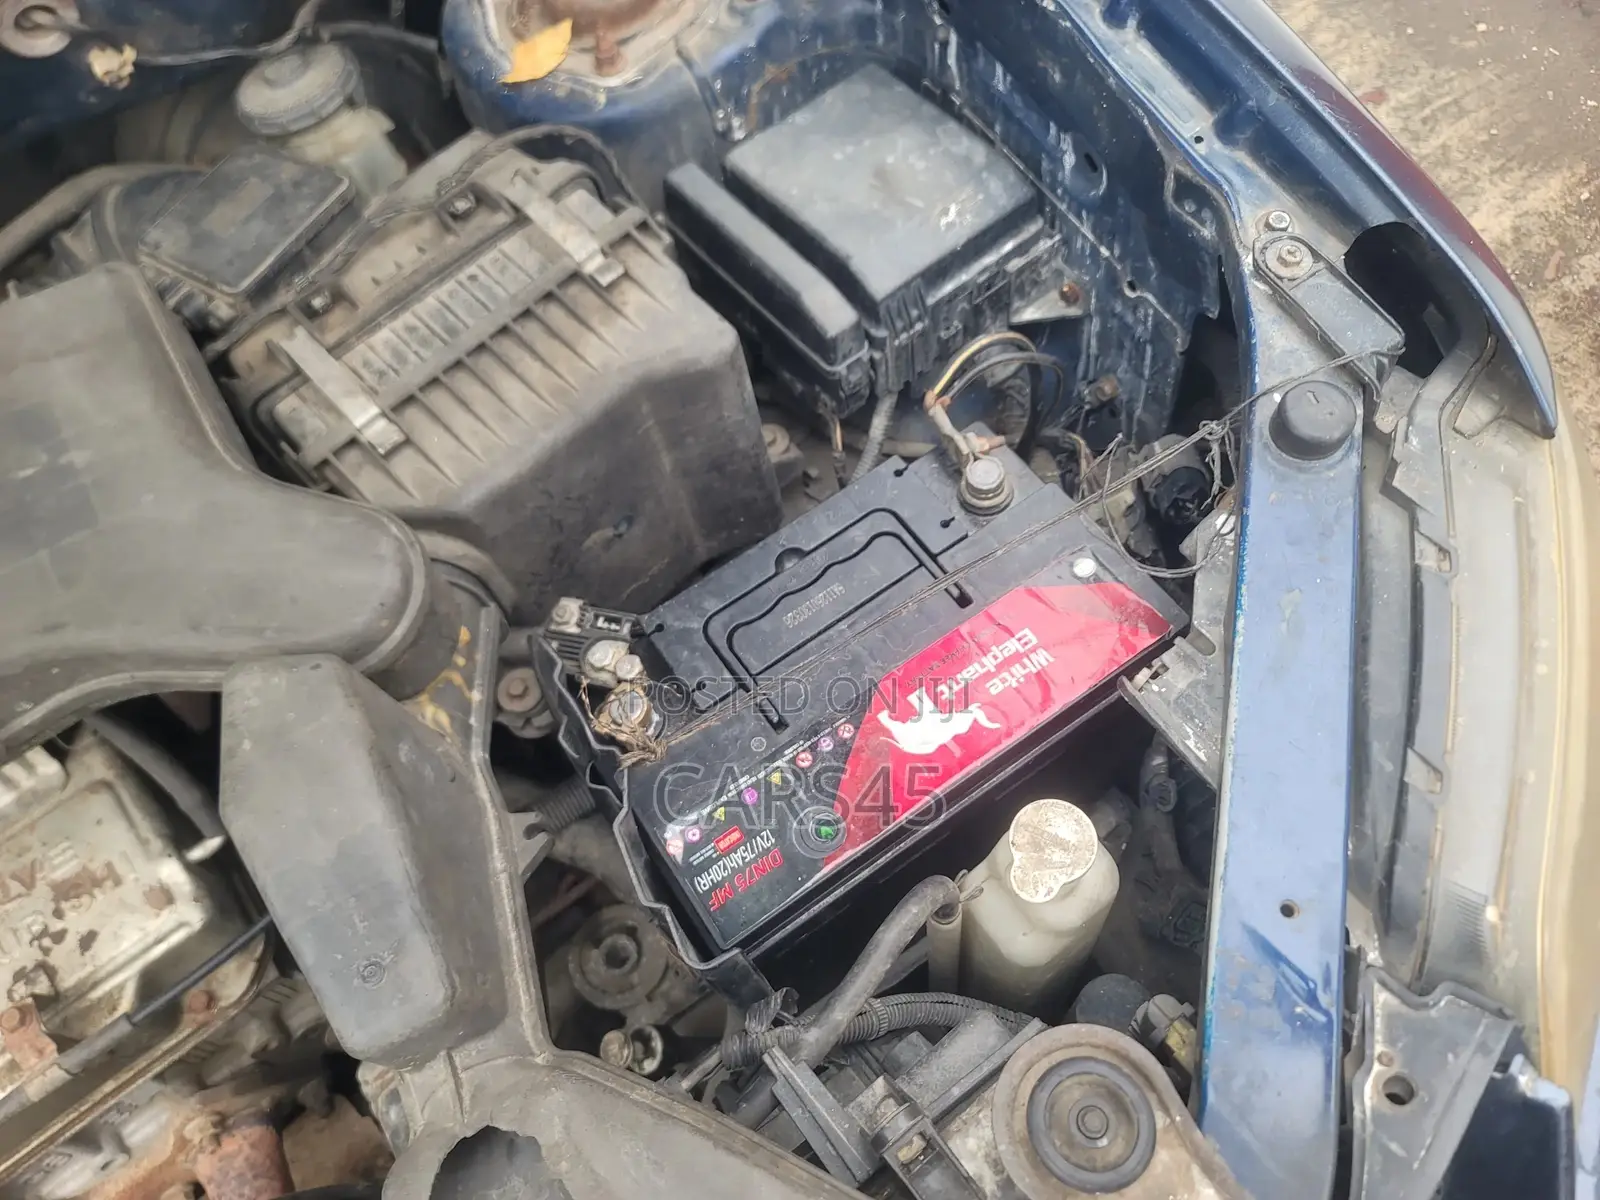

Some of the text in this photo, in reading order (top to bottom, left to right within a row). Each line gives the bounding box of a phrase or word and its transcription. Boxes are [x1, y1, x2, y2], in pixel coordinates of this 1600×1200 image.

[934, 627, 1039, 699] Elephant
[985, 646, 1053, 696] White
[692, 828, 776, 892] 12V/75Ah(20HR)
[734, 848, 784, 892] DIN75
[705, 881, 734, 911] MF
